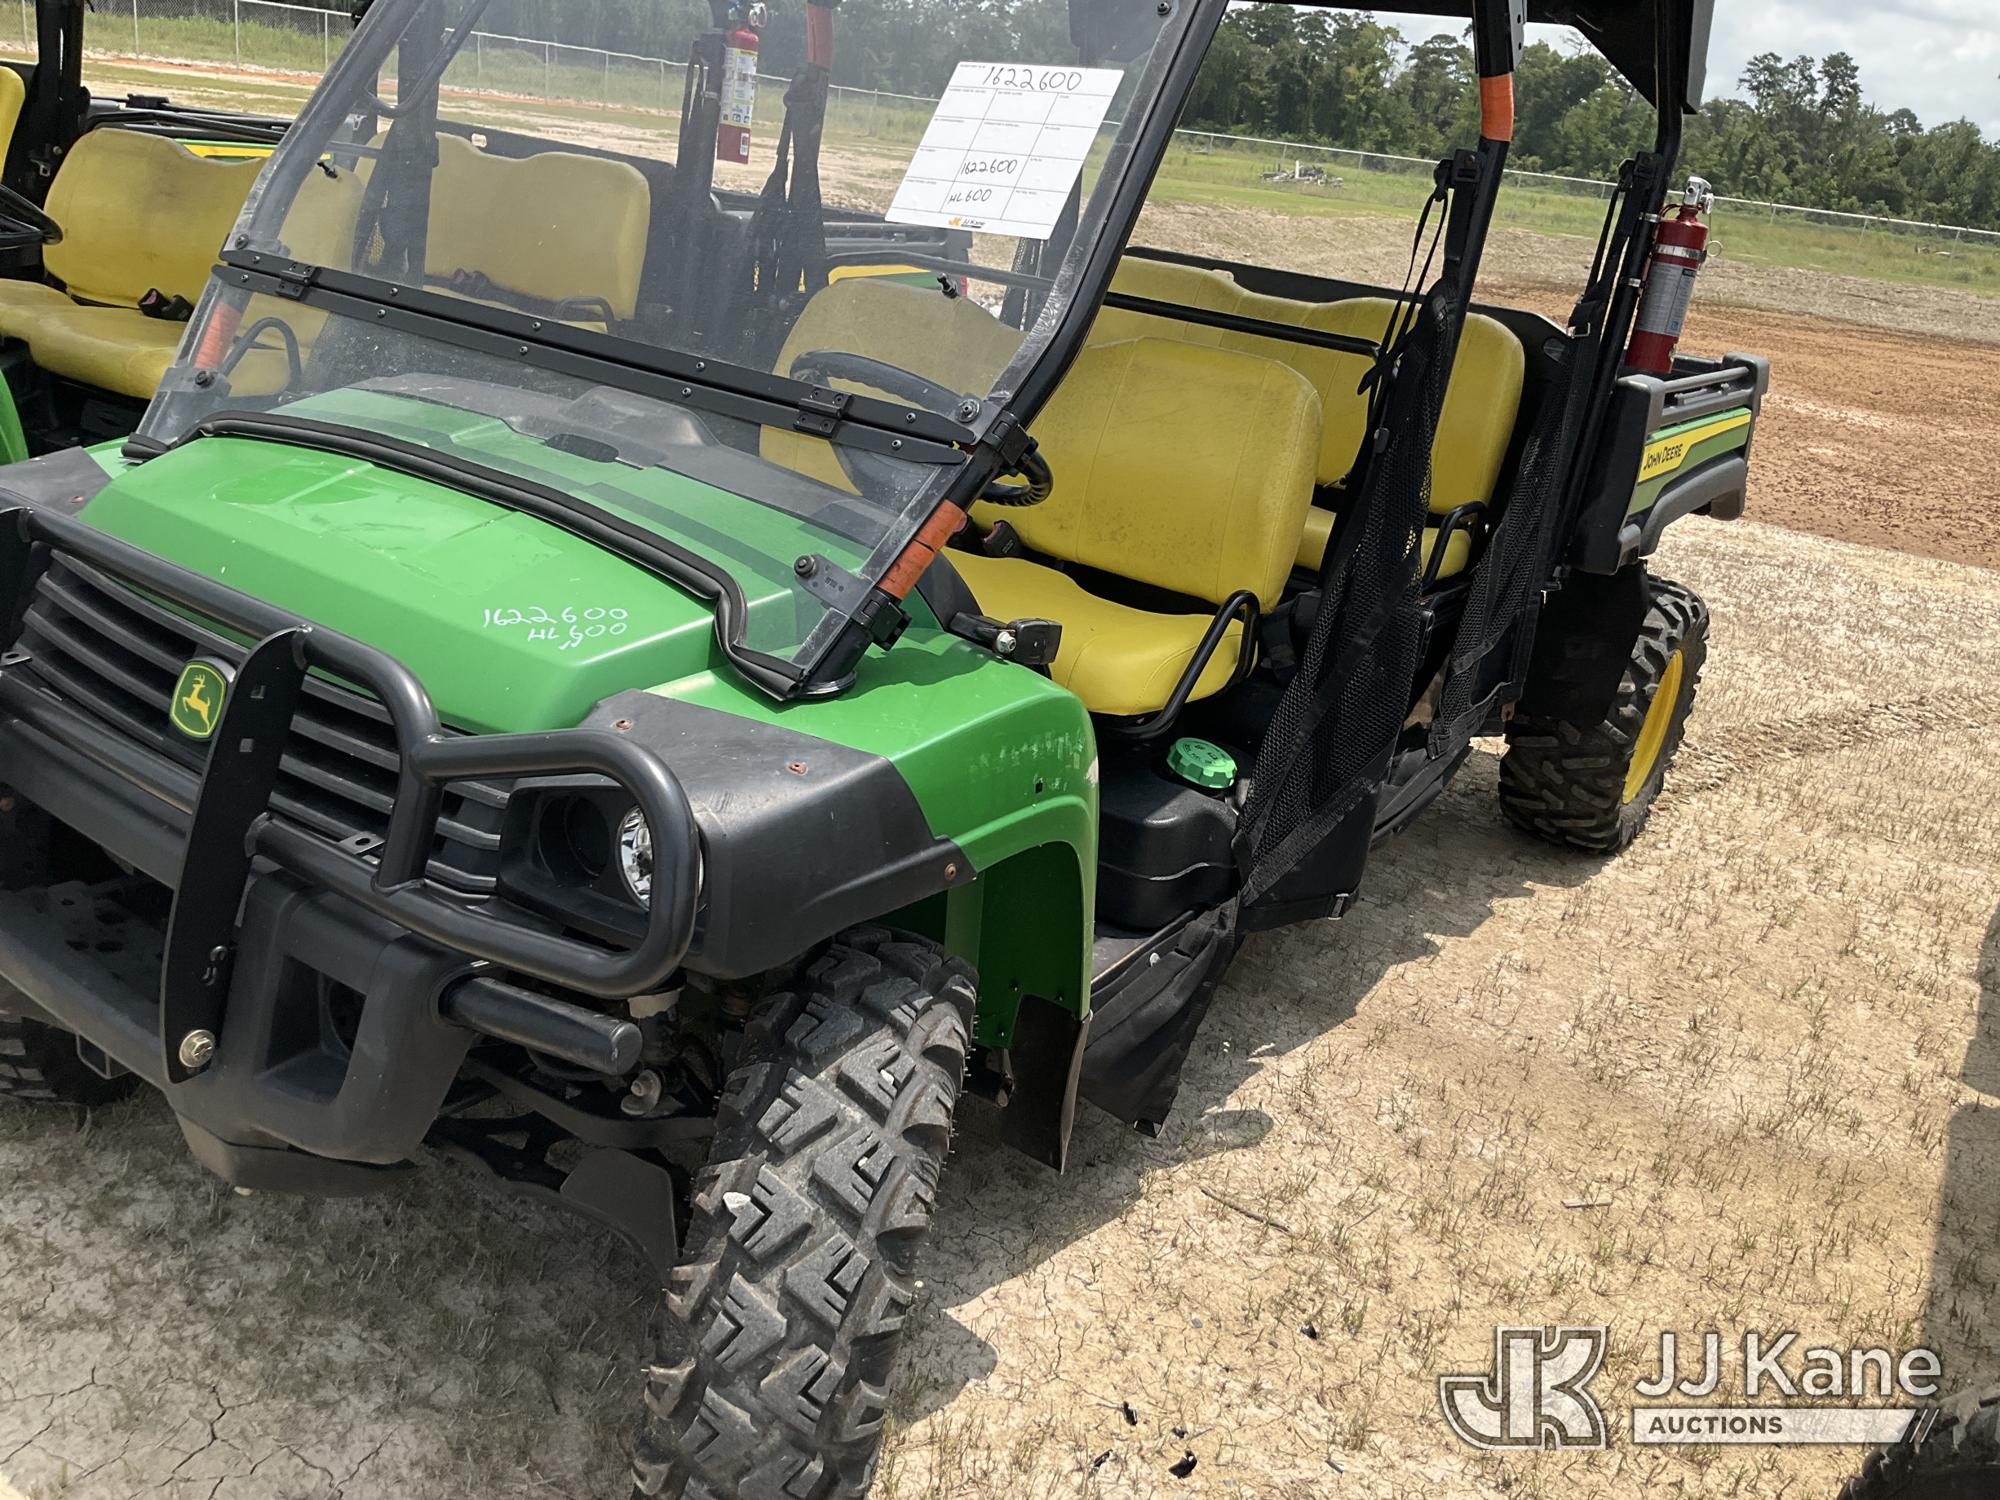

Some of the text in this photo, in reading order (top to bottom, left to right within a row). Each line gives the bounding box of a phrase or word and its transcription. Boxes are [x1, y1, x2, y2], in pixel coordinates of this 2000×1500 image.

[983, 66, 1081, 91] 1622600
[961, 160, 1017, 174] 1622600
[1661, 443, 1683, 463] DEERE
[484, 606, 628, 628] 1622600
